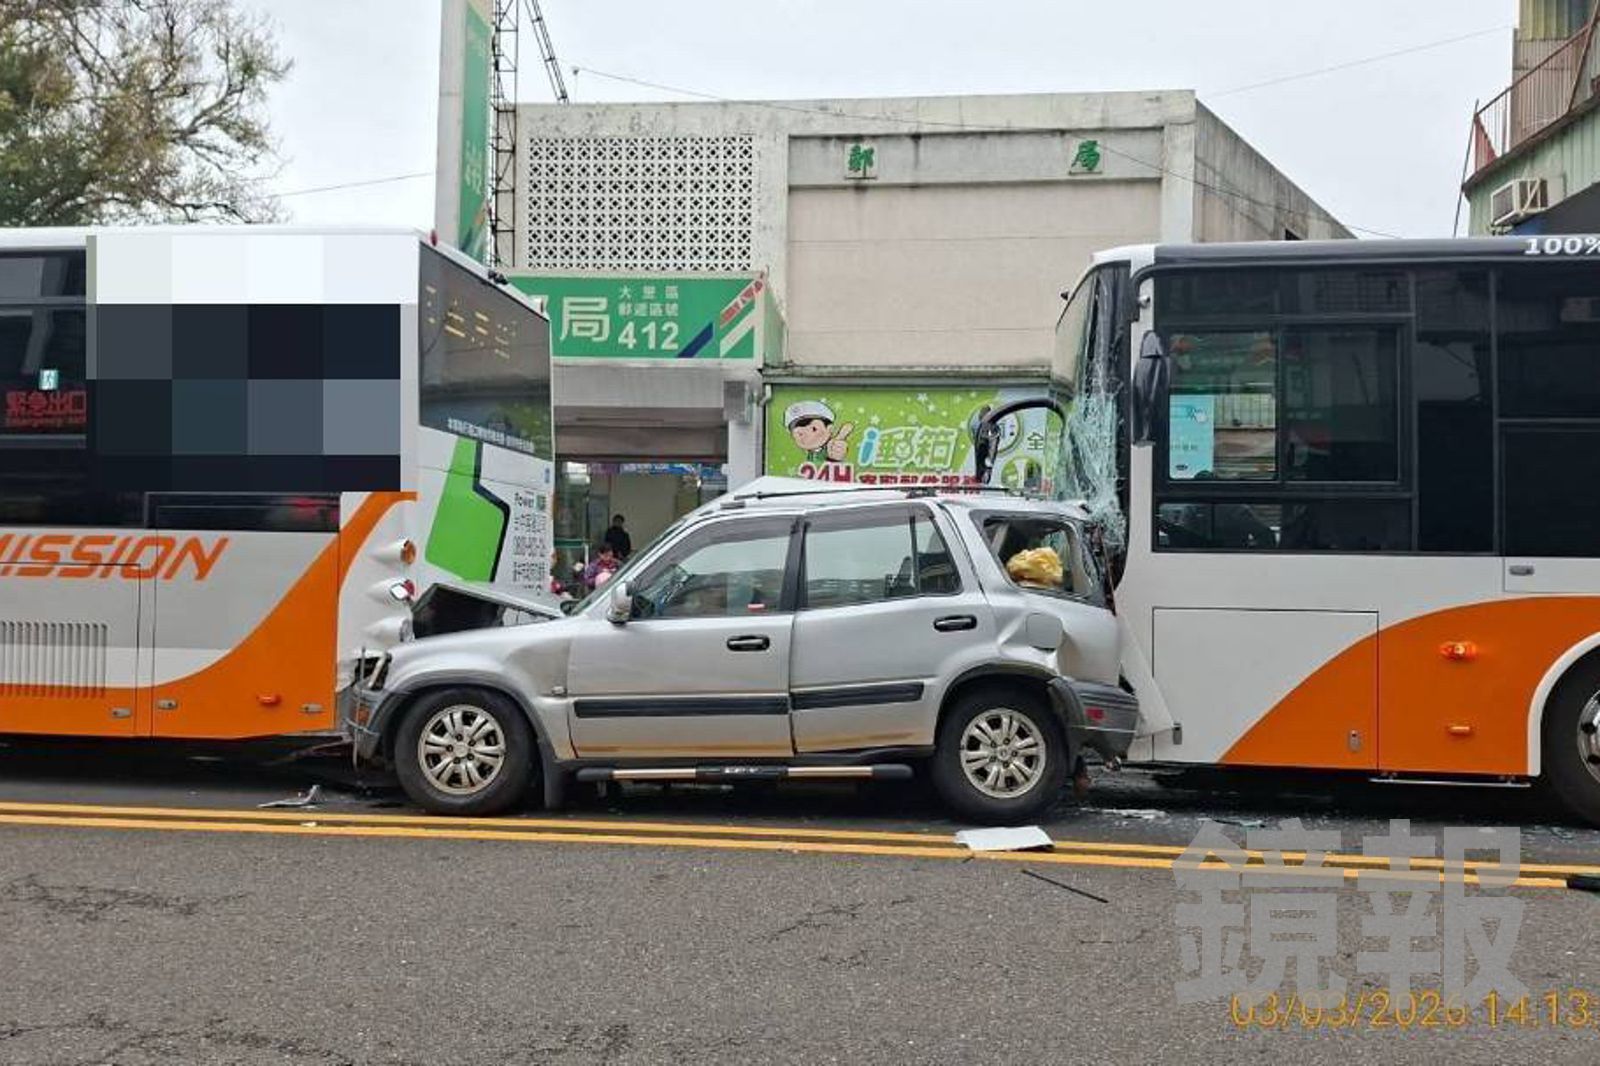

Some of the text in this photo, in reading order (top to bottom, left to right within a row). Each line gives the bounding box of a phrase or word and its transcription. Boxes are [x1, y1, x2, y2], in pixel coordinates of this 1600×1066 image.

[1524, 237, 1600, 255] 100%
[617, 321, 679, 350] 412
[6, 390, 87, 417] 緊急出口
